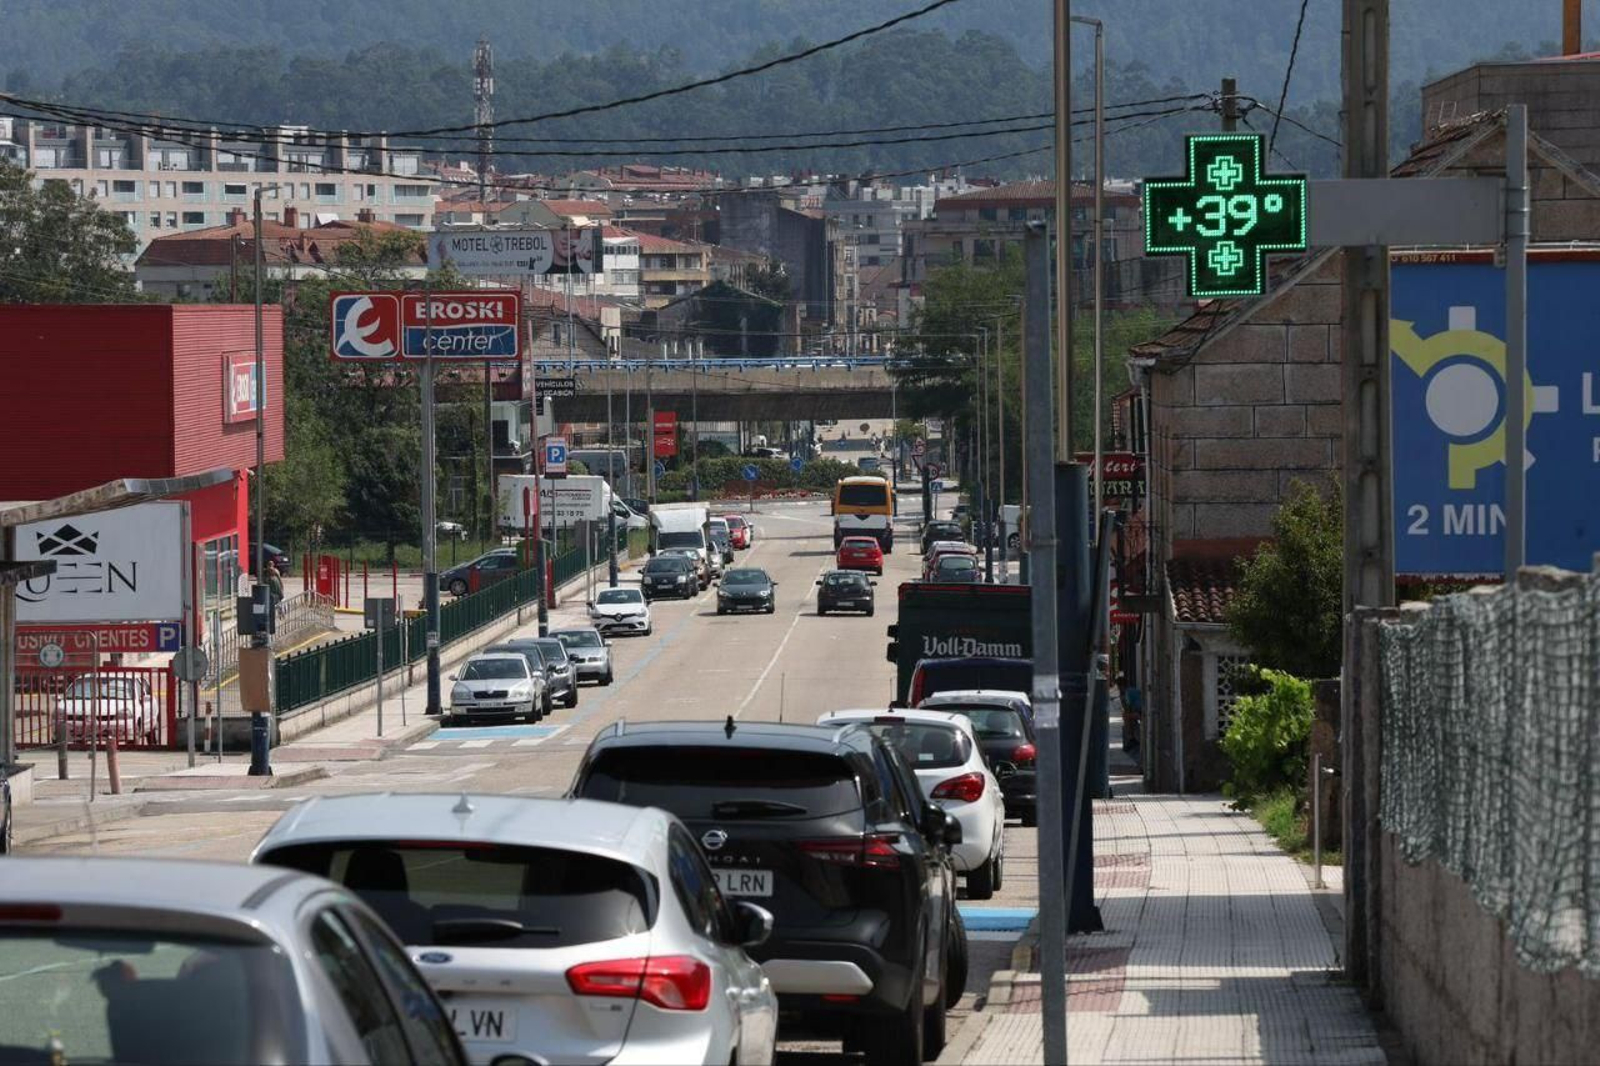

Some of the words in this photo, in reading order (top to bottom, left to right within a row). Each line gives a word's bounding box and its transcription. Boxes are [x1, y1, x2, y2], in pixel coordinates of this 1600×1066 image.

[452, 238, 488, 251] MOTEL
[504, 236, 547, 250] TREBOL
[415, 301, 503, 319] EROSKI
[422, 329, 498, 351] center
[551, 448, 560, 461] P
[1407, 504, 1429, 535] 2
[15, 561, 138, 603] UEEN
[159, 627, 175, 648] P
[921, 635, 1022, 657] Voll-Damm
[727, 873, 765, 892] LRN
